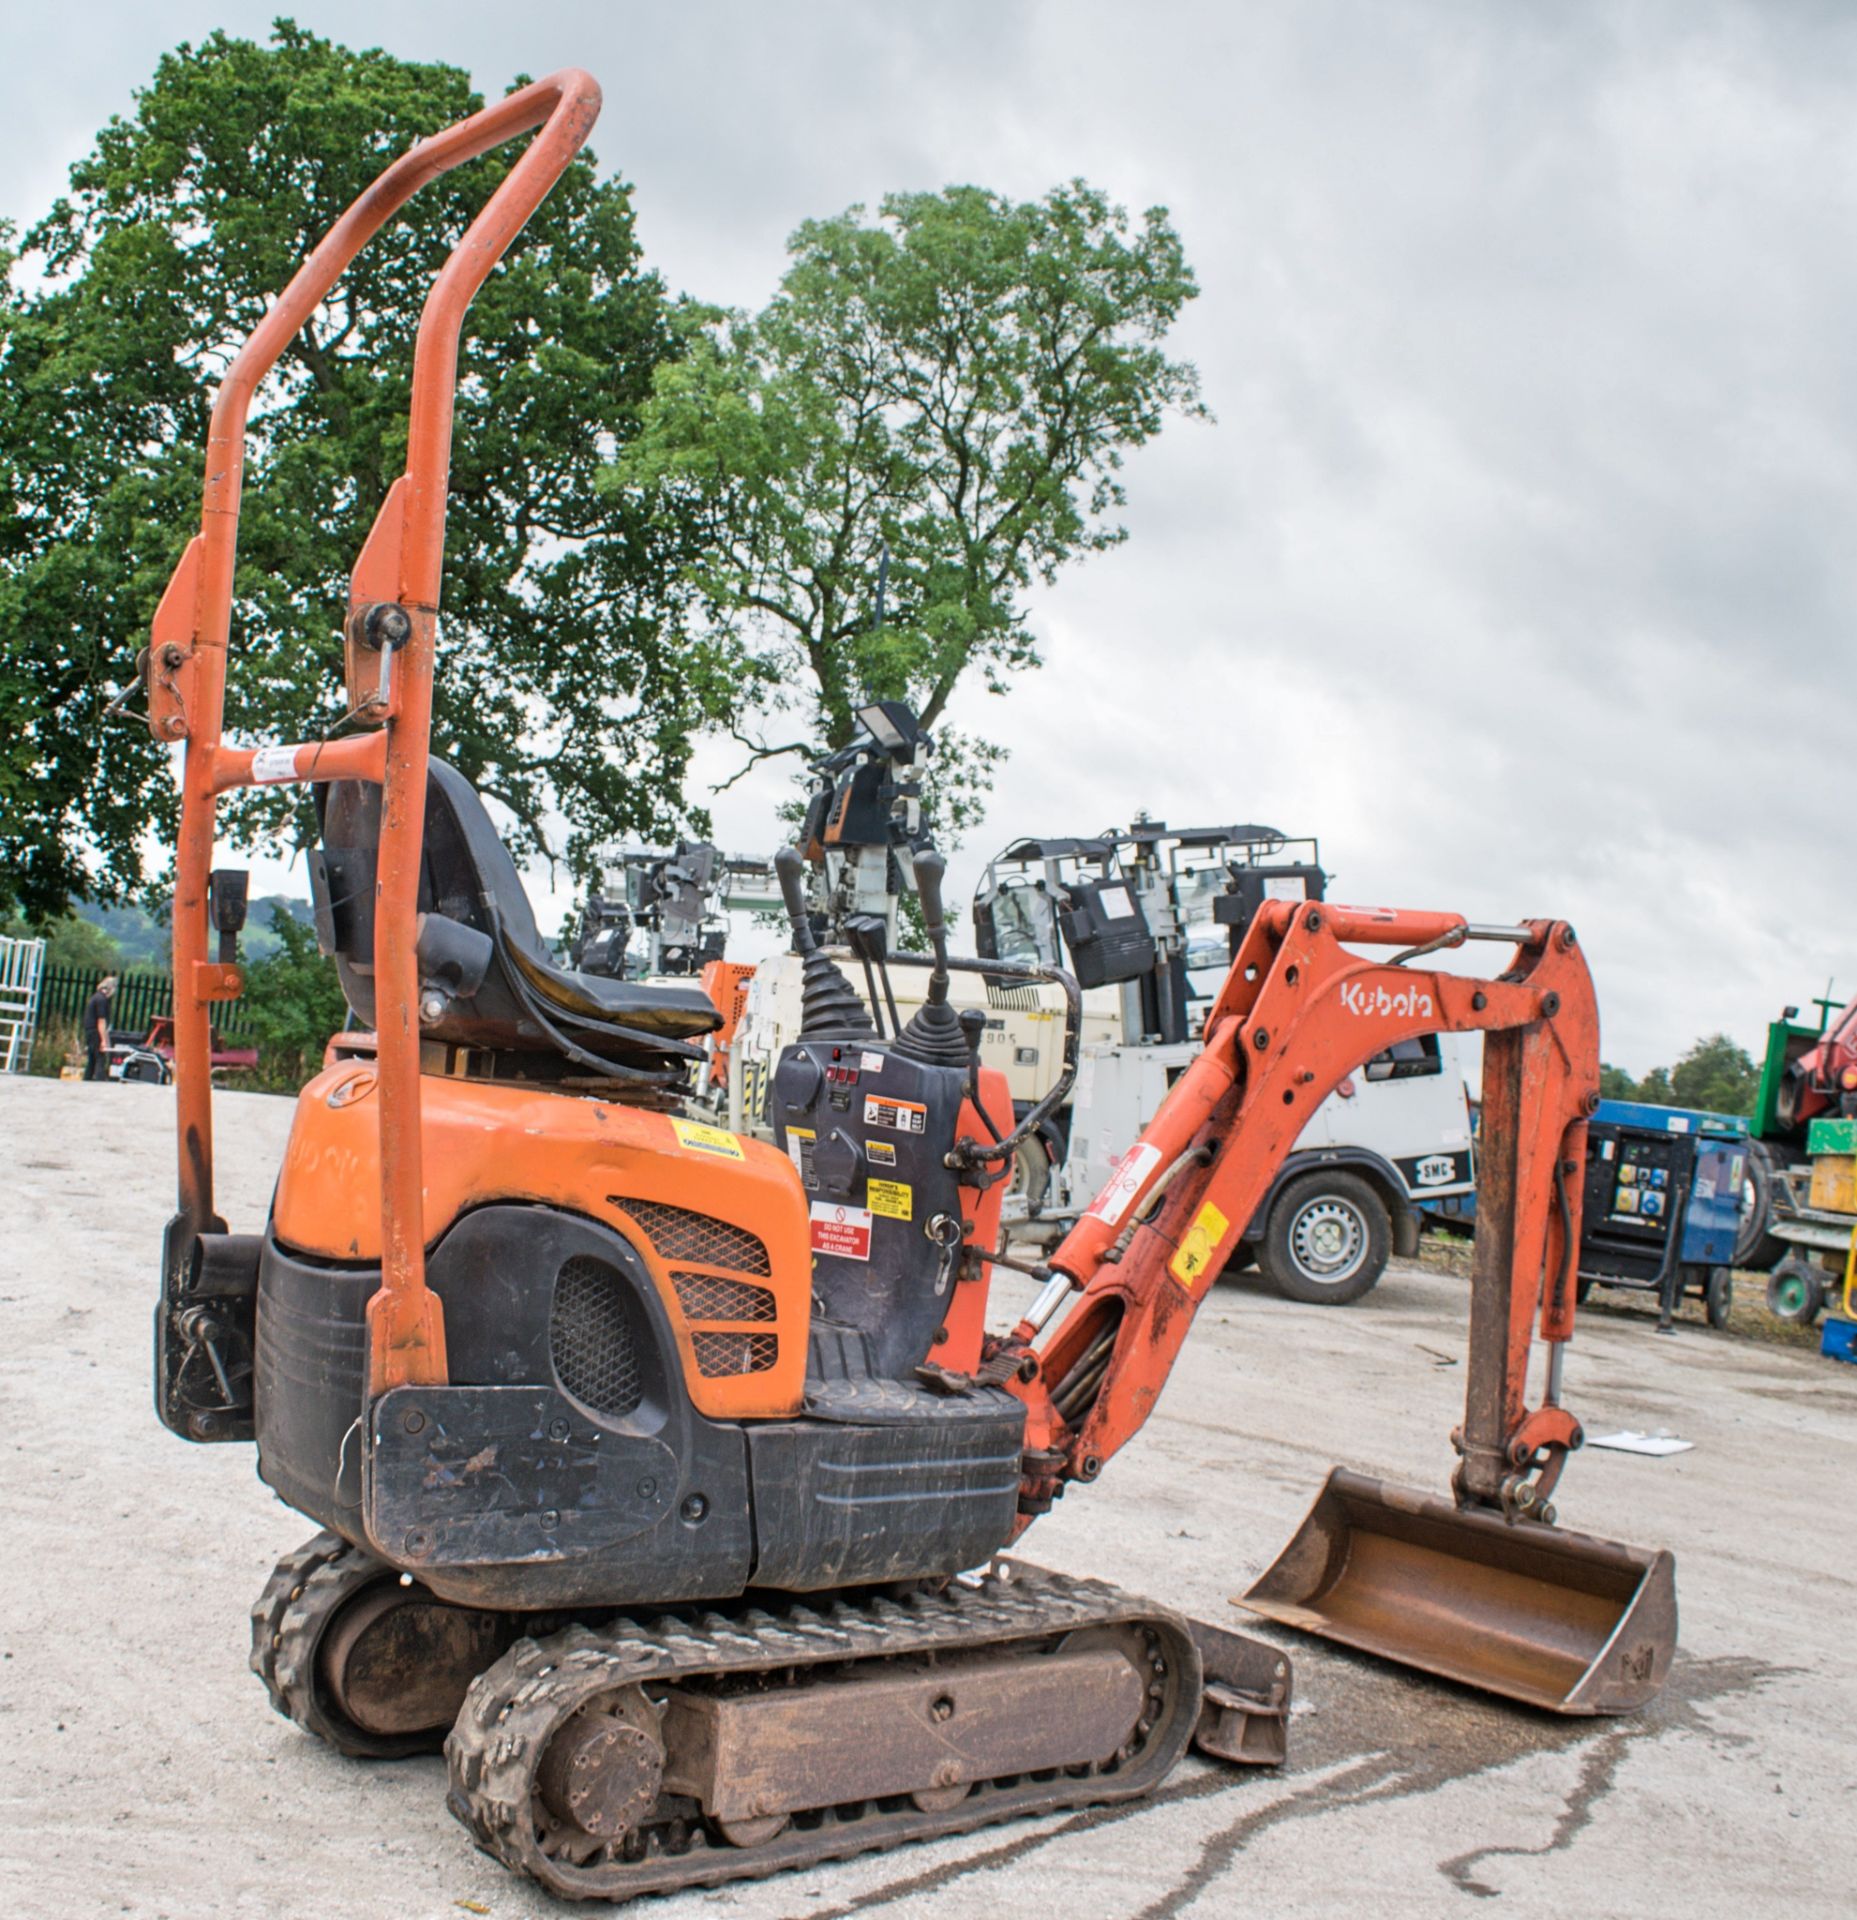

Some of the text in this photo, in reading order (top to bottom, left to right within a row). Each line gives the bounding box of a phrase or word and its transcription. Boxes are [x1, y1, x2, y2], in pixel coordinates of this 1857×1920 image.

[1341, 982, 1433, 1017] Kubota
[1424, 1163, 1448, 1178] SMC
[869, 1186, 909, 1198] RESPONSIBILITY
[823, 1223, 855, 1235] DO NOT USE
[817, 1231, 860, 1245] THIS EXCAVATOR
[834, 1244, 853, 1254] CRANE
